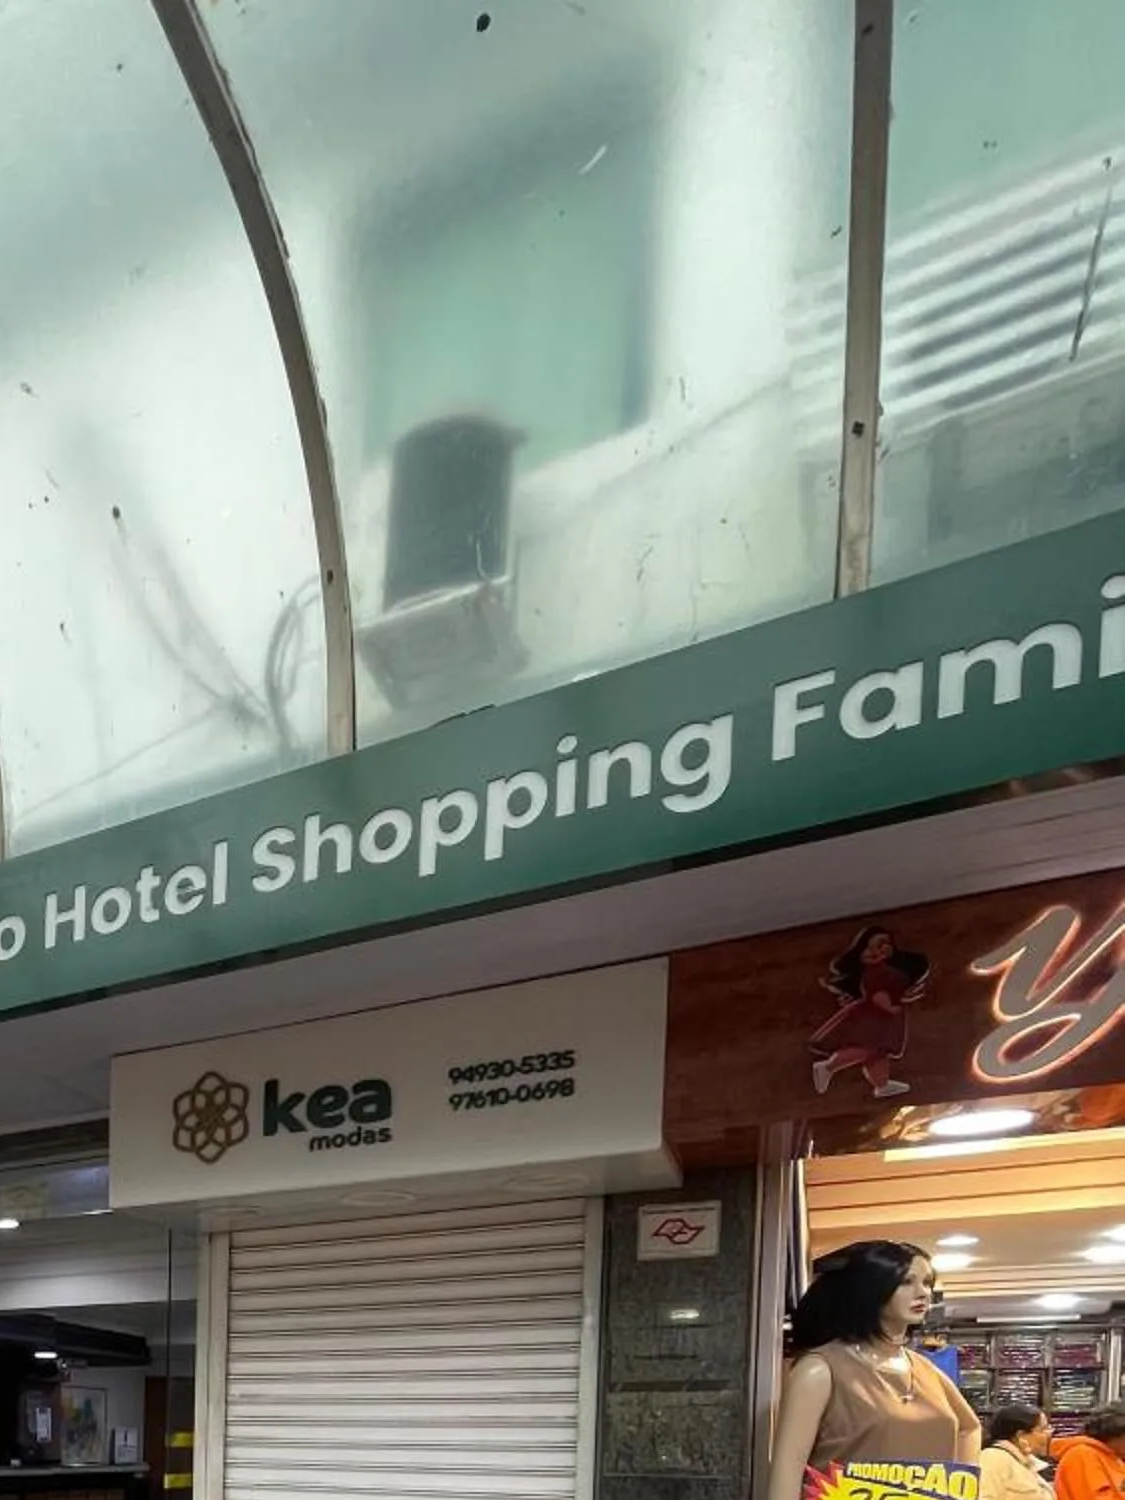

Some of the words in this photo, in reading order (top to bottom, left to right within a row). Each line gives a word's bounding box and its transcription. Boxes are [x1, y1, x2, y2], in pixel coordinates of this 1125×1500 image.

[43, 842, 229, 952] Hotel
[251, 713, 734, 878] Shopping
[771, 573, 1125, 762] Fami
[448, 1049, 575, 1085] 94930-5335
[263, 1078, 393, 1137] kea
[448, 1077, 575, 1112] 97610-0698
[309, 1126, 393, 1153] modas
